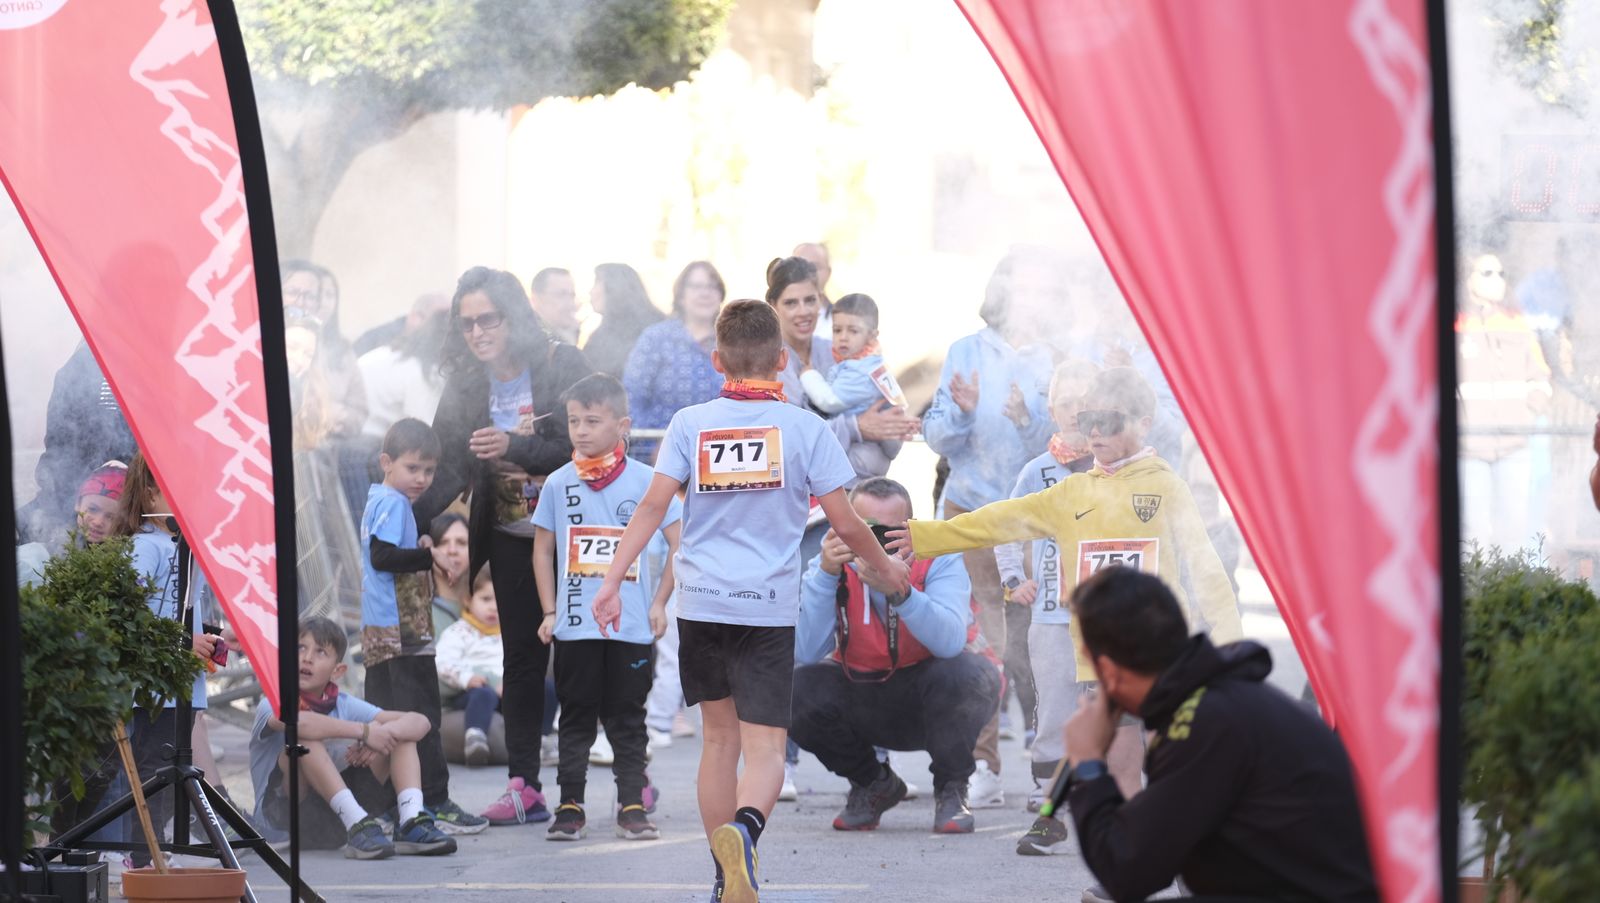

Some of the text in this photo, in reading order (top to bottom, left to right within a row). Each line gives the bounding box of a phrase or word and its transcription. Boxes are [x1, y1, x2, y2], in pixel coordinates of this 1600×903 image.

[710, 441, 764, 464] 717
[565, 483, 581, 508] LA
[1091, 553, 1140, 574] 751
[684, 585, 721, 596] COSENTINO
